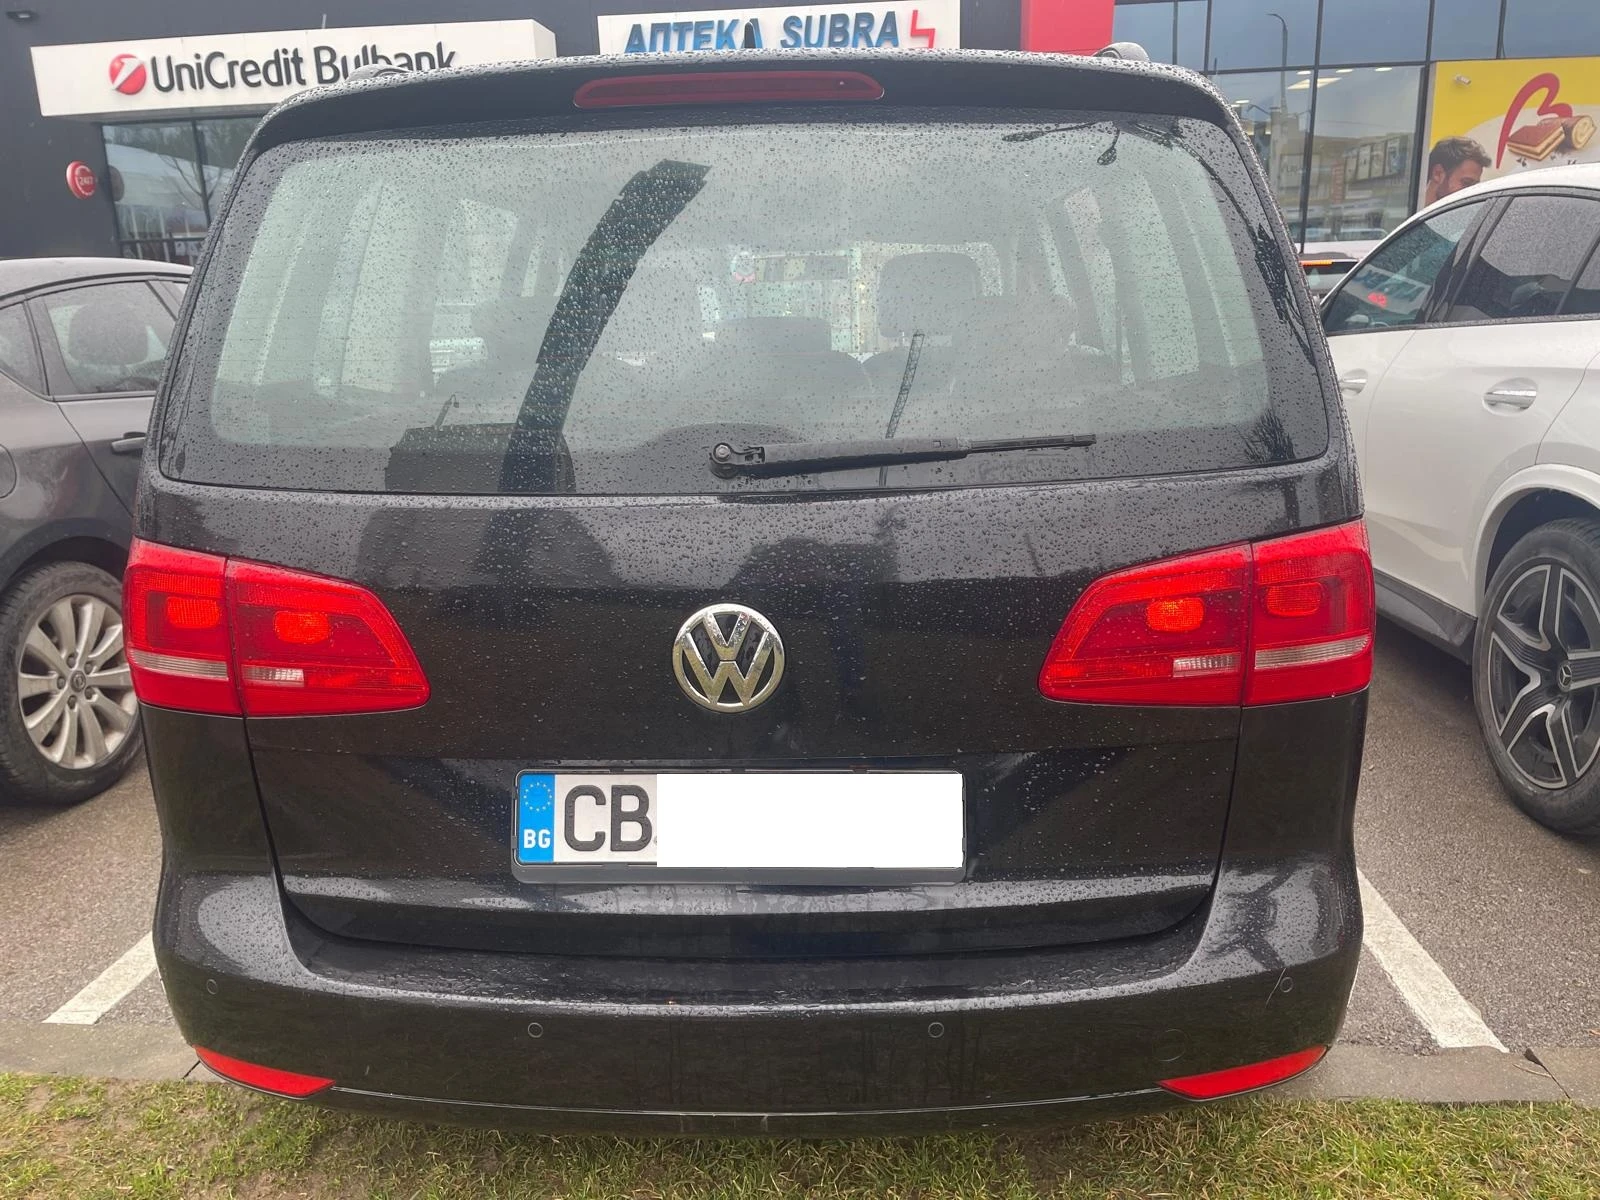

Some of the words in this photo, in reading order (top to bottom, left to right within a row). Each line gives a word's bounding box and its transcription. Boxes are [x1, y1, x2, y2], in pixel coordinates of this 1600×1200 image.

[780, 11, 899, 48] SUBRA
[151, 48, 307, 92] UniCredit
[564, 784, 652, 851] CB
[523, 829, 551, 848] BG
